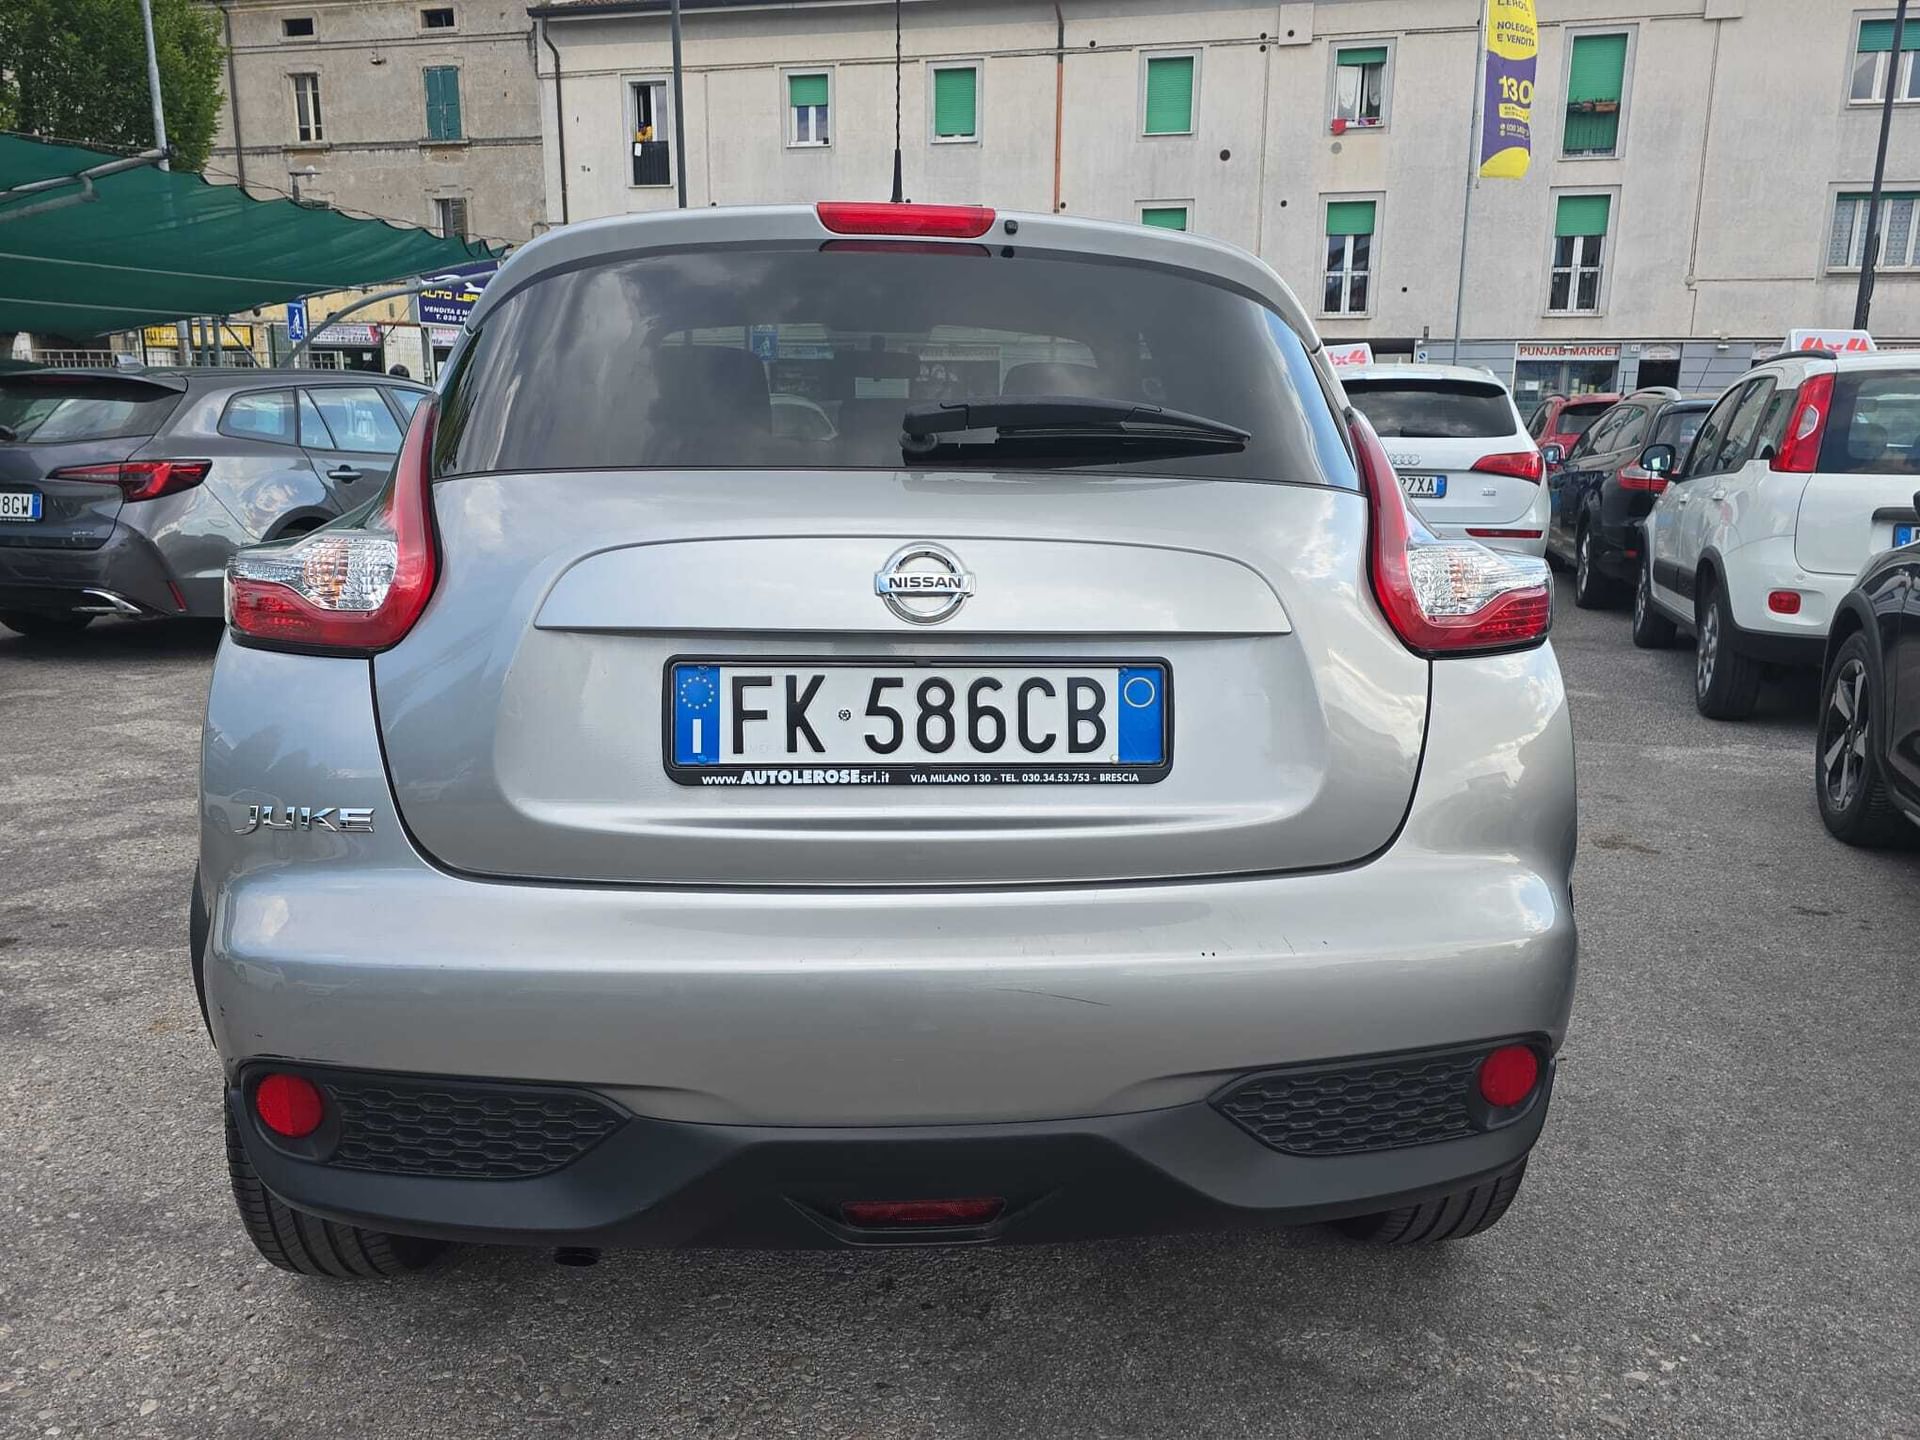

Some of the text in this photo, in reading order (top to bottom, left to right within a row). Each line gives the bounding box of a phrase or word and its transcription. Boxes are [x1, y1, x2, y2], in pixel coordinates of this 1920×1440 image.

[1506, 34, 1535, 47] VENDITA
[1499, 75, 1534, 104] 130
[421, 290, 480, 302] AUTO LER
[424, 306, 455, 314] VENDITA
[1519, 346, 1567, 357] PUNJAB
[1570, 345, 1619, 356] MARKET
[0, 496, 30, 515] 8GW
[888, 576, 961, 589] NISSAN
[731, 674, 826, 755] FK
[864, 676, 1107, 755] 586CB
[701, 769, 891, 785] www.AUTOLEROSEsrl.it
[910, 773, 928, 783] VIA
[930, 773, 971, 783] MILANO
[973, 773, 991, 783] 130
[1001, 773, 1020, 783] TEL.
[1022, 773, 1090, 783] 030.34.53.753
[1099, 773, 1139, 783] BRESCIA
[234, 805, 375, 835] JUKE
